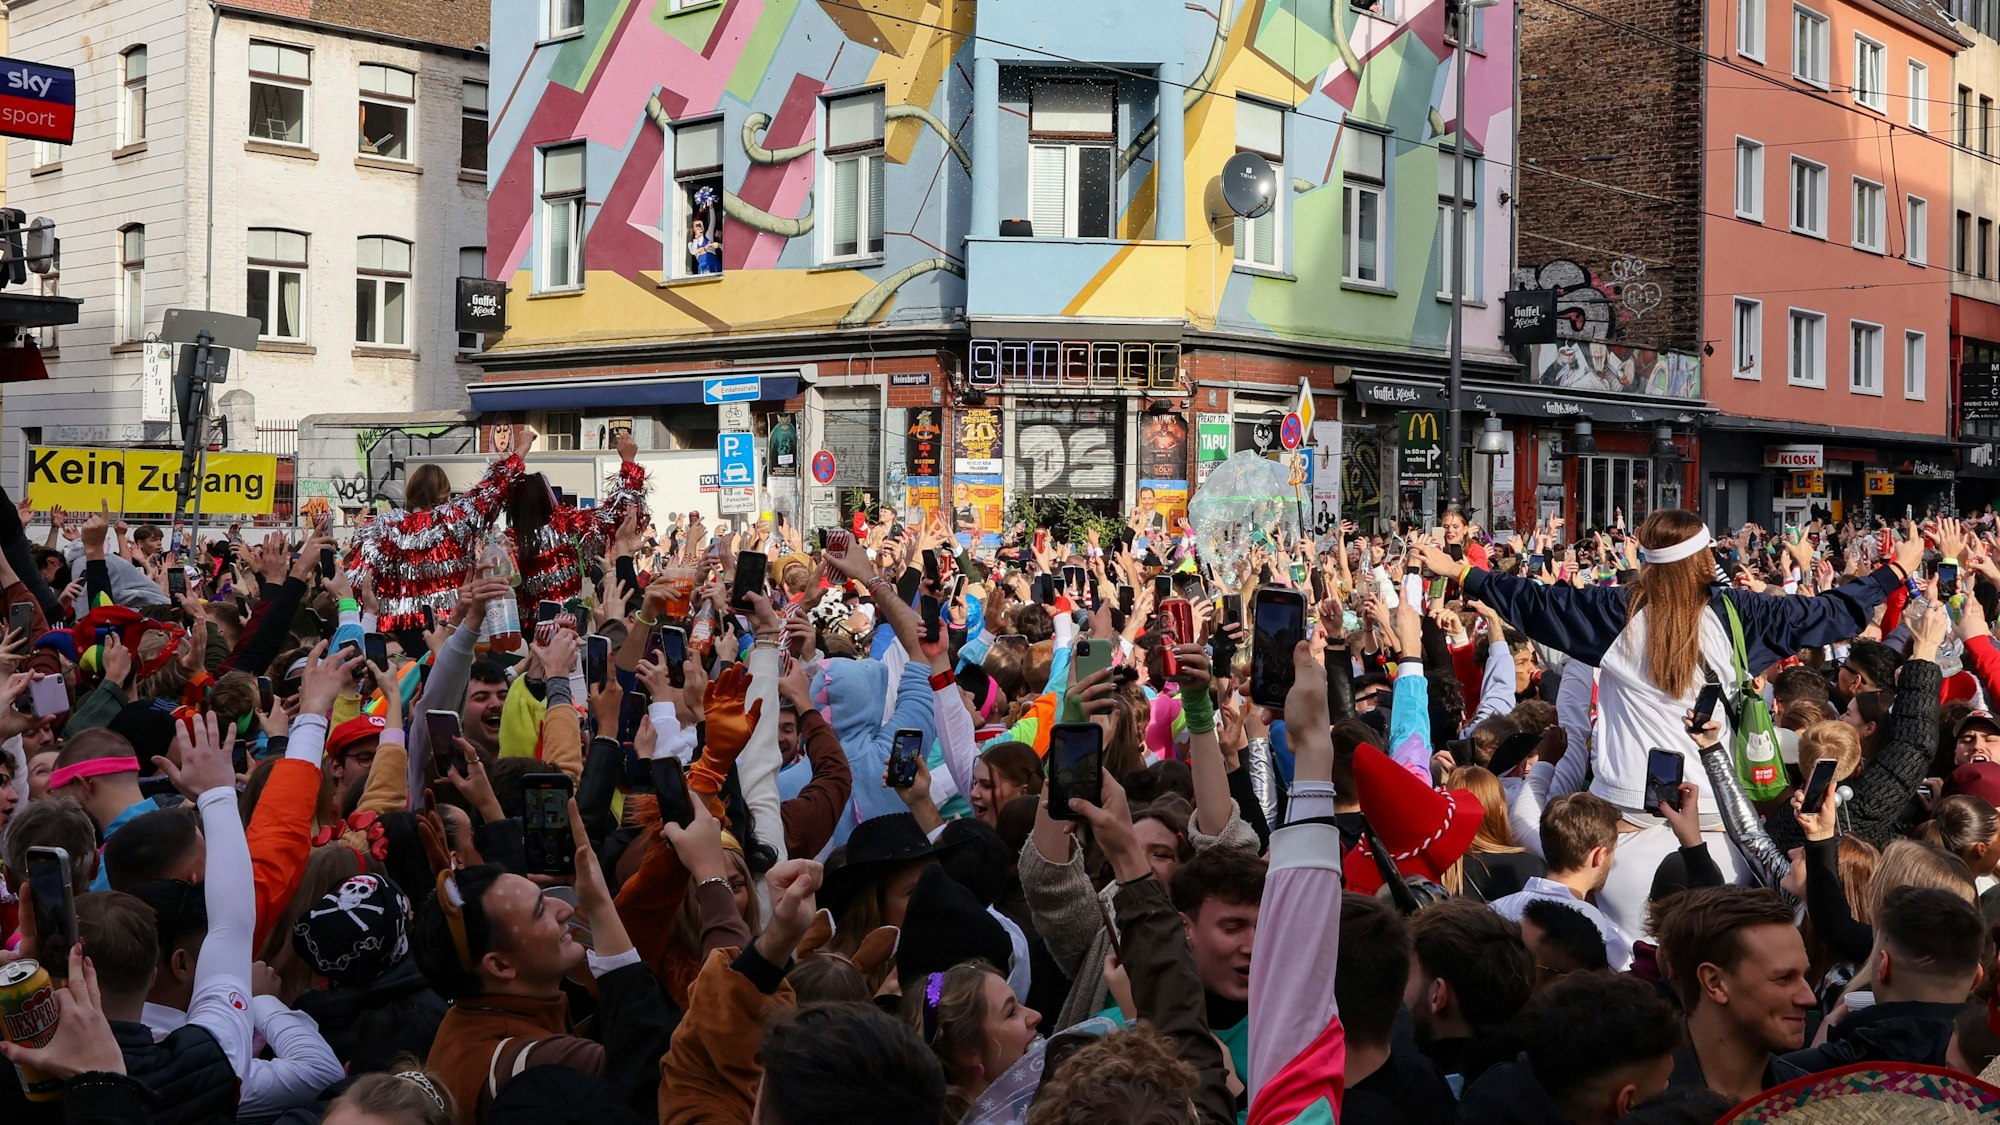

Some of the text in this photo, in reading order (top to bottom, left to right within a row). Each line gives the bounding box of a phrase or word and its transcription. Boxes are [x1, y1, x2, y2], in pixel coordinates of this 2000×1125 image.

[7, 68, 53, 97] sky
[2, 107, 56, 127] sport
[1240, 172, 1257, 180] TRIAX
[472, 293, 497, 307] Gaffel
[470, 305, 497, 318] Kölsch
[1514, 305, 1540, 318] Gaffel
[1513, 316, 1540, 329] Kölsch
[974, 345, 1177, 382] STIEFEL
[893, 374, 927, 385] Heinsbergstr.
[720, 384, 757, 394] Einbahnstraße
[1373, 386, 1395, 401] Gaffel
[961, 416, 999, 424] FREUNDE
[1200, 415, 1226, 423] READY TO
[724, 437, 740, 457] P
[1201, 434, 1227, 450] TABU
[1781, 454, 1816, 465] KIOSK
[28, 450, 125, 485] Kein
[700, 475, 715, 485] TOI
[1933, 470, 1956, 479] DELIVERY
[372, 717, 385, 725] M
